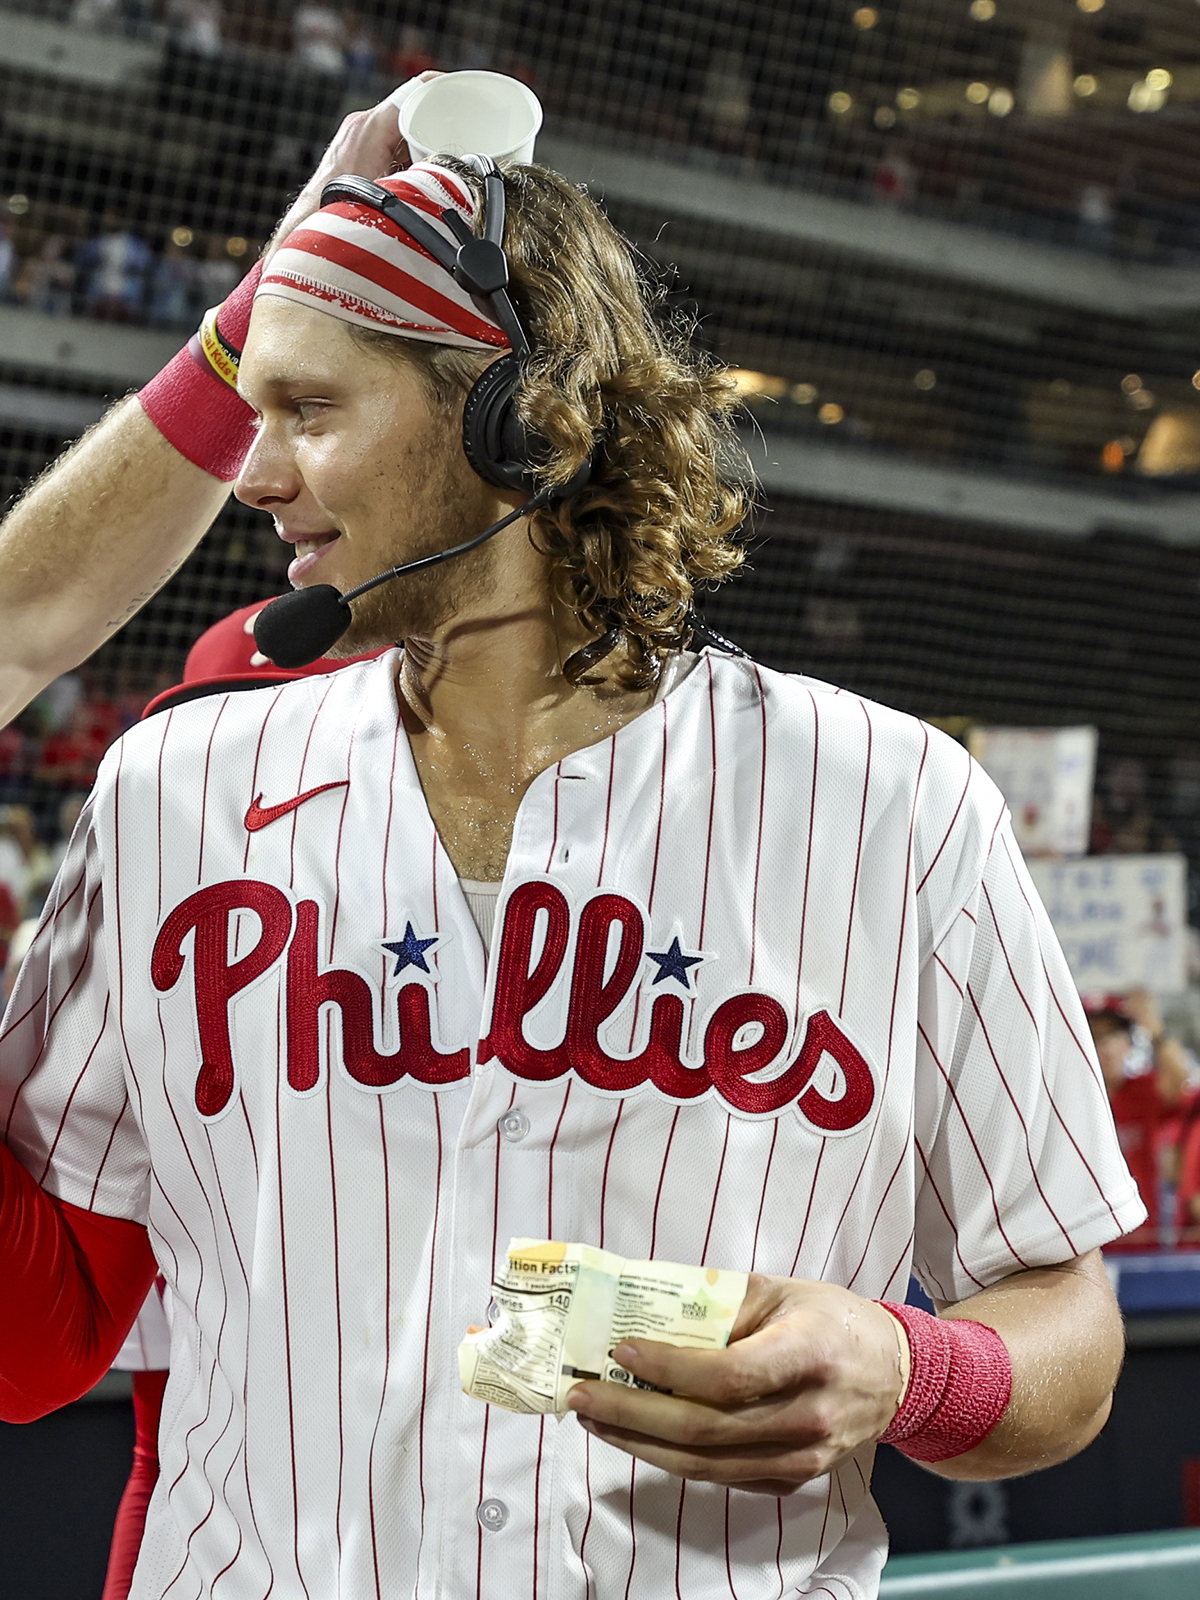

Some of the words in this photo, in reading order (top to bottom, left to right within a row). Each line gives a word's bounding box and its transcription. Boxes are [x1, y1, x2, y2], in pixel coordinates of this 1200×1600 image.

[211, 349, 232, 376] Kids
[150, 879, 876, 1132] Phillies
[541, 1262, 577, 1274] Facts
[548, 1294, 570, 1310] 140
